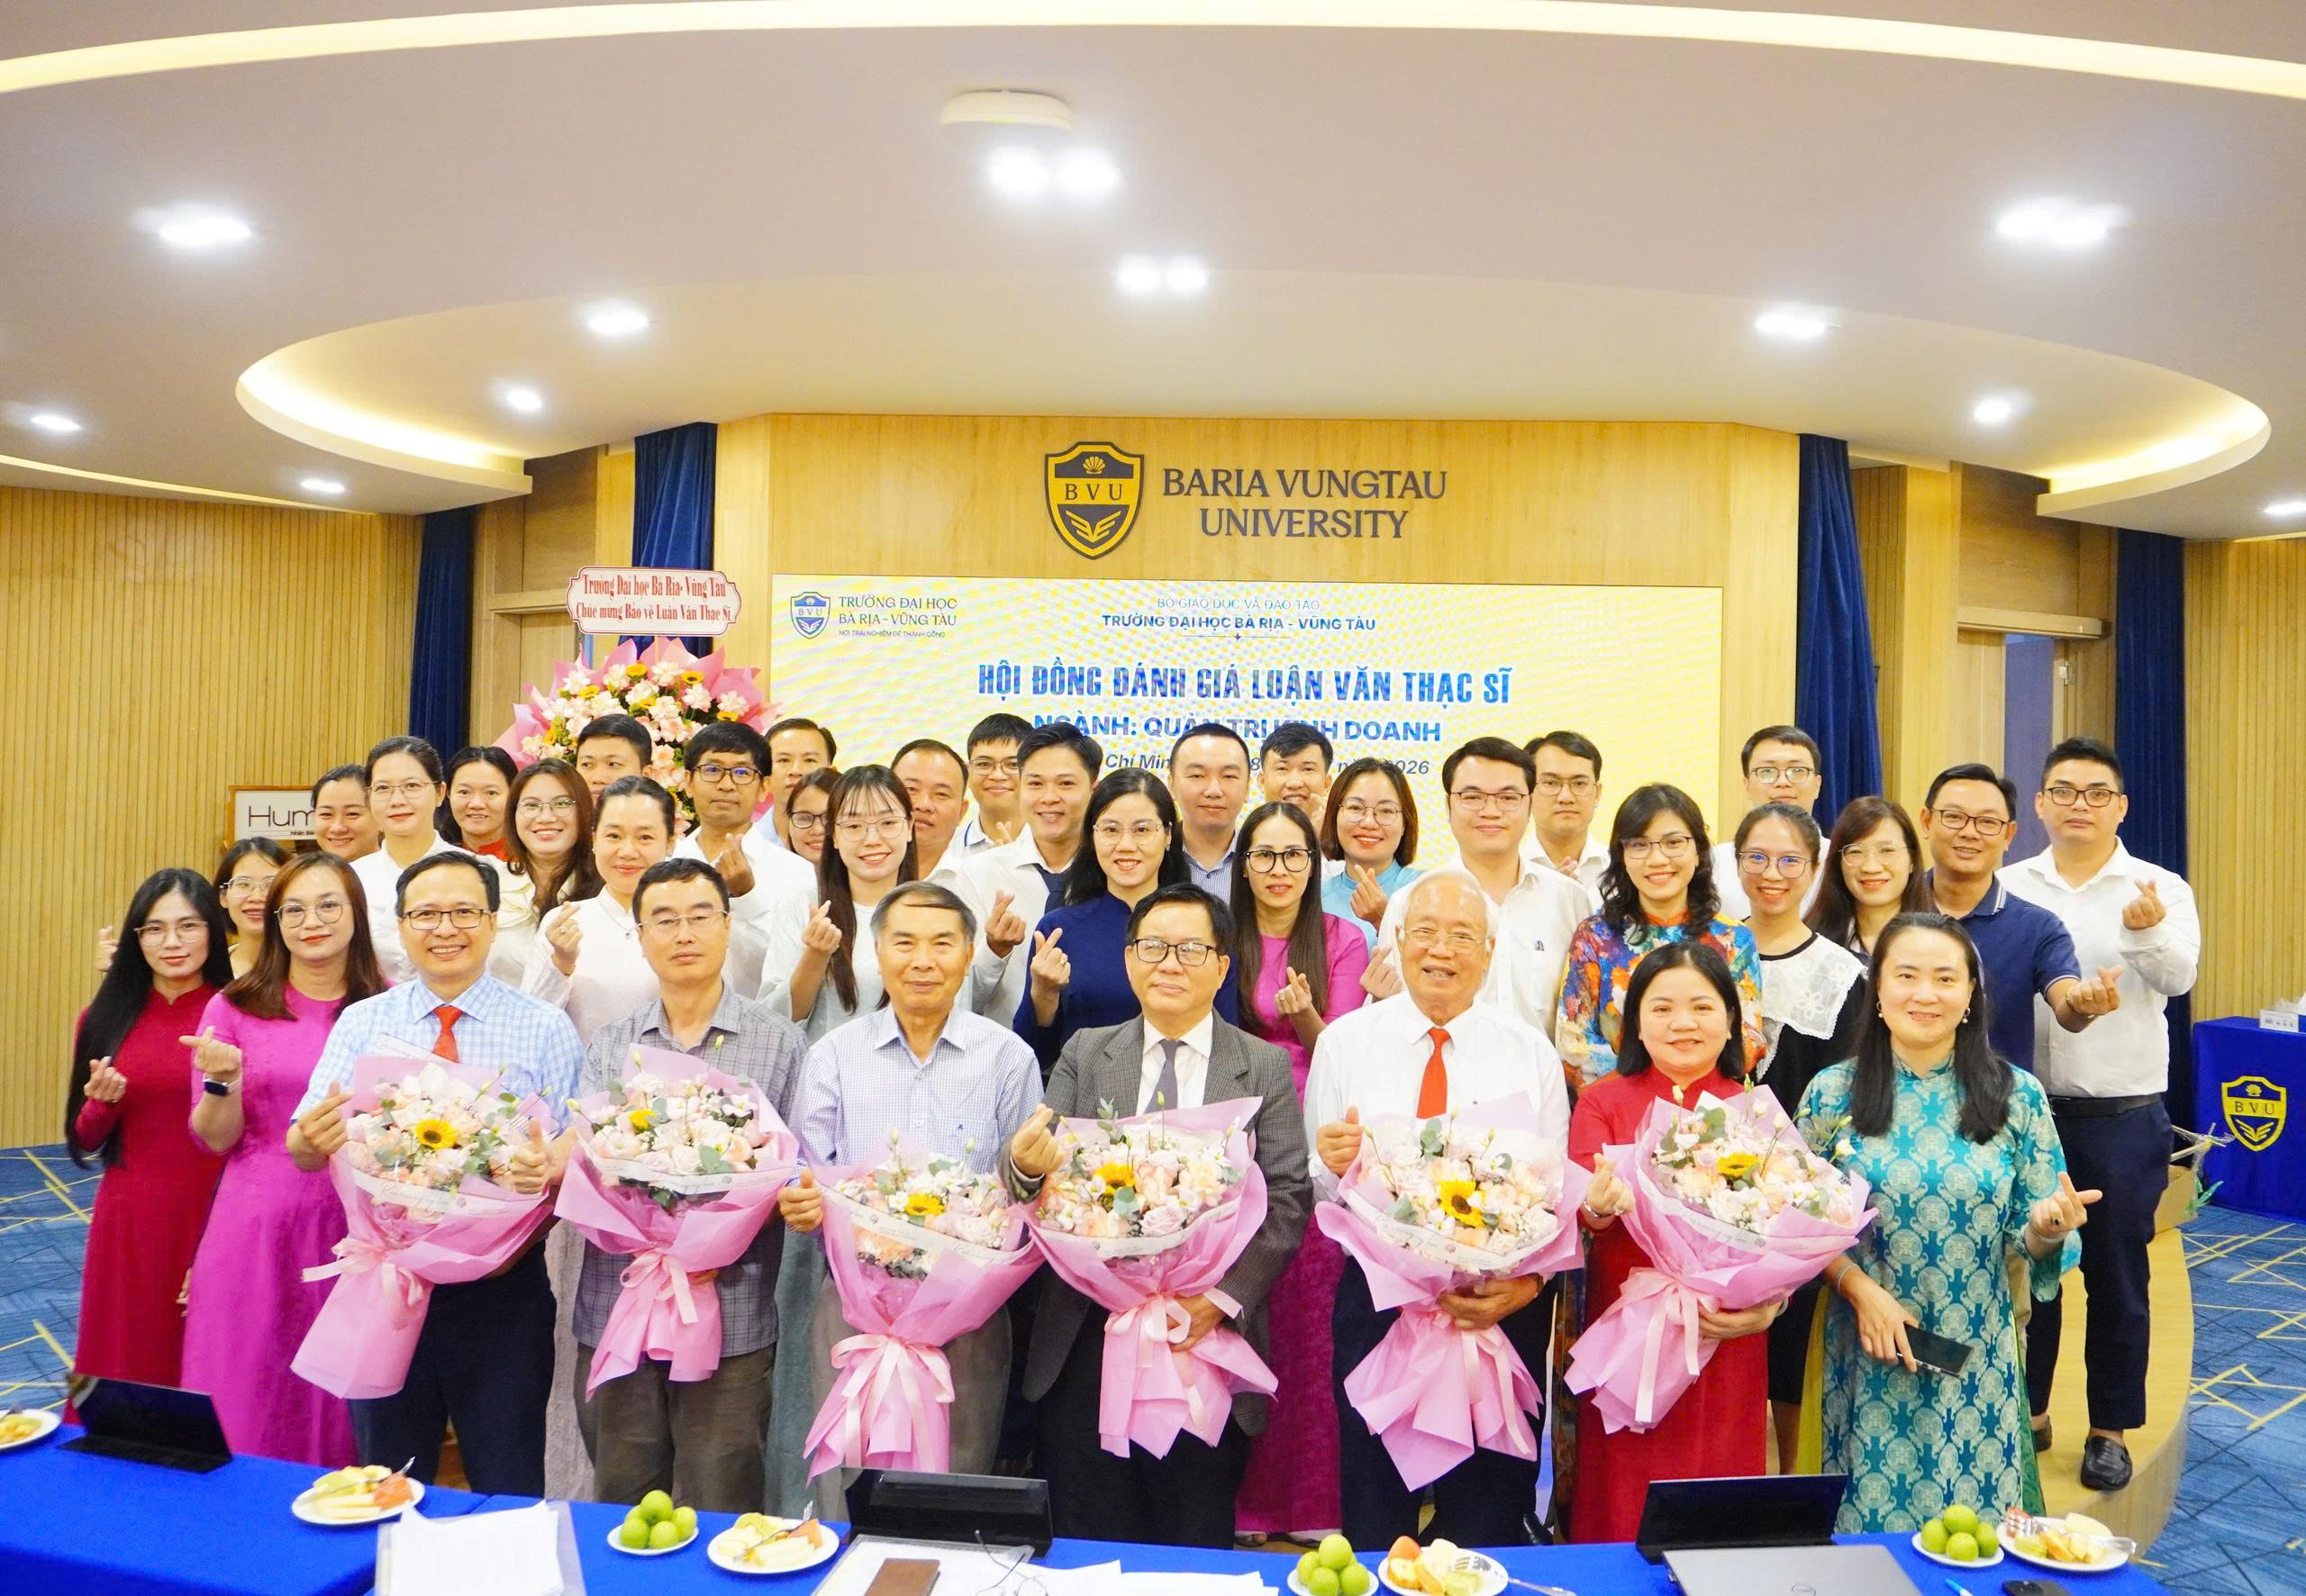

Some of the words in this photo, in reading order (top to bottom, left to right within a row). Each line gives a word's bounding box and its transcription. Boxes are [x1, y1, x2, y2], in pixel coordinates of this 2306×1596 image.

[1162, 467, 1269, 497] BARIA
[1276, 469, 1448, 500] VUNGTAU
[1199, 508, 1409, 539] UNIVERSITY
[584, 574, 614, 599] Trường
[633, 575, 649, 598] học
[576, 602, 597, 619] Chúc
[599, 602, 623, 621] mừng
[839, 594, 895, 609] TRƯỜNG
[899, 597, 922, 611] ĐẠI
[926, 598, 958, 612] HỌC
[1244, 597, 1260, 610] VÀ
[839, 611, 856, 624] BÀ
[859, 613, 881, 627] RỊA
[890, 612, 929, 626] VŨNG
[931, 612, 958, 626] TÀU
[1102, 612, 1166, 627] TRƯỜNG
[1168, 616, 1195, 630] ĐẠI
[1198, 617, 1231, 630] HỌC
[1234, 614, 1255, 629] BÀ
[1259, 617, 1284, 631] RỊA
[1298, 615, 1342, 630] VŨNG
[1346, 615, 1375, 630] TÀU
[978, 659, 1021, 701] HỘI
[1032, 657, 1102, 696] ĐỒNG
[1113, 662, 1186, 698] ĐÁNH
[1196, 664, 1240, 699] GIÁ
[1252, 665, 1323, 706] LUẬN
[1334, 666, 1391, 701] VĂN
[1403, 672, 1473, 710] THẠC
[1484, 667, 1513, 703] SĨ
[1144, 712, 1220, 737] QUẢ
[1345, 721, 1440, 741] DOANH
[1105, 754, 1135, 768] Chí
[1392, 759, 1430, 775] 026
